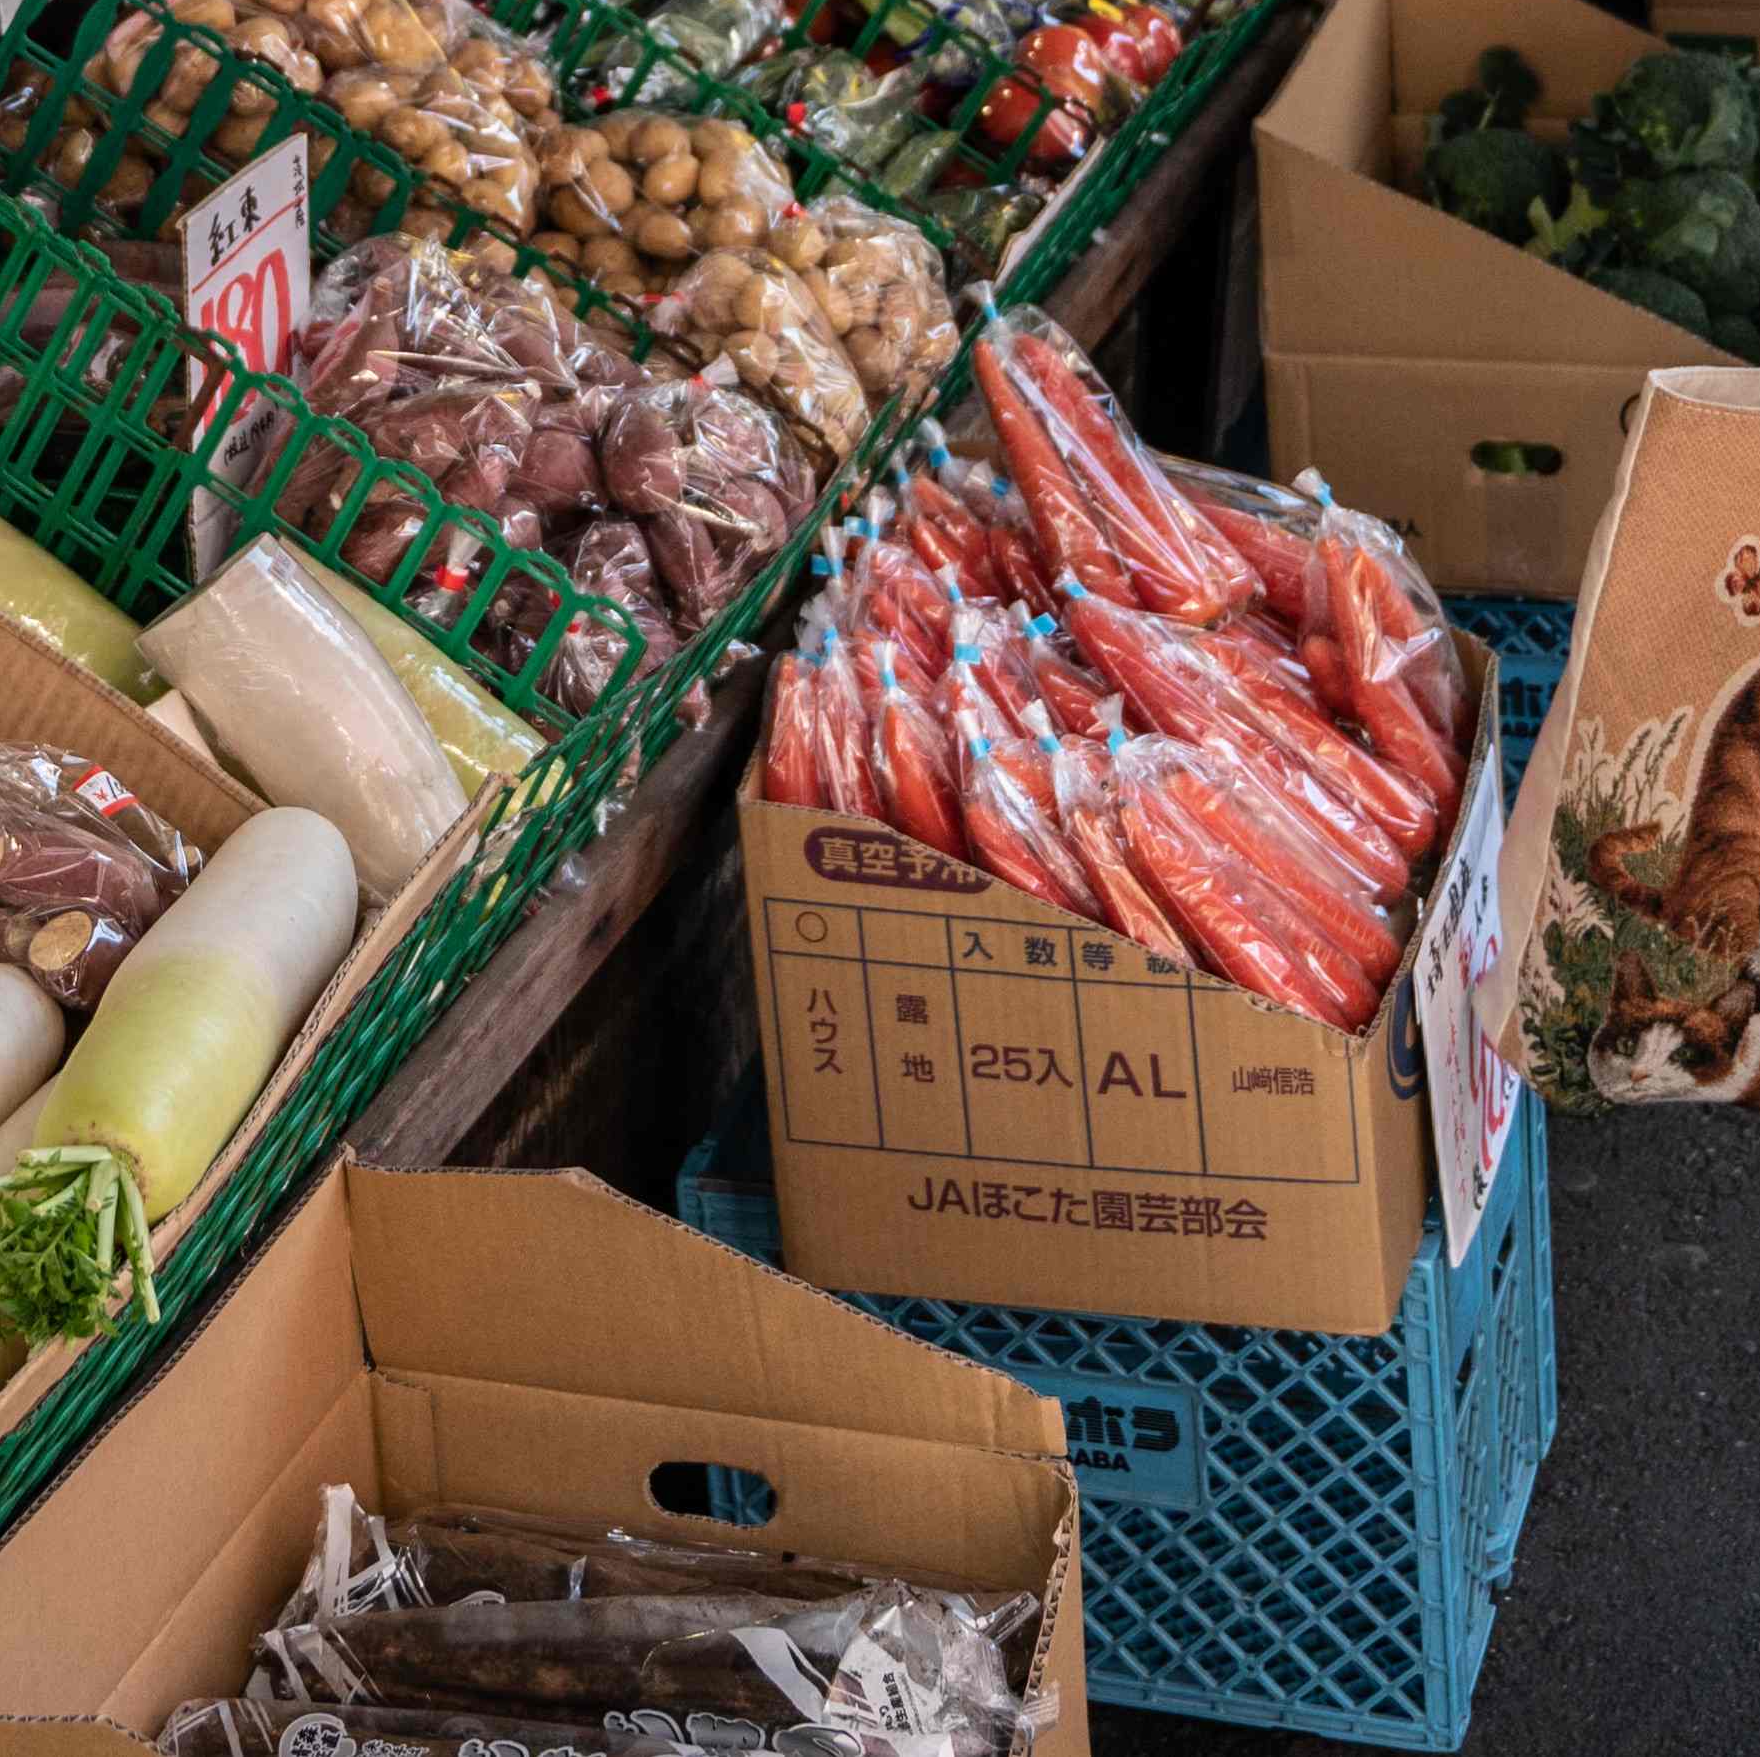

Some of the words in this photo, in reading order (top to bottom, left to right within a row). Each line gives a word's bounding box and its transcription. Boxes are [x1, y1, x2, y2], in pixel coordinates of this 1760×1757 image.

[806, 987, 843, 1075] ハウス
[970, 1044, 1074, 1091] 25入
[1096, 1051, 1188, 1100] AL
[907, 1176, 1268, 1241] JAほこた園芸部会
[1065, 1448, 1131, 1473] ABA
